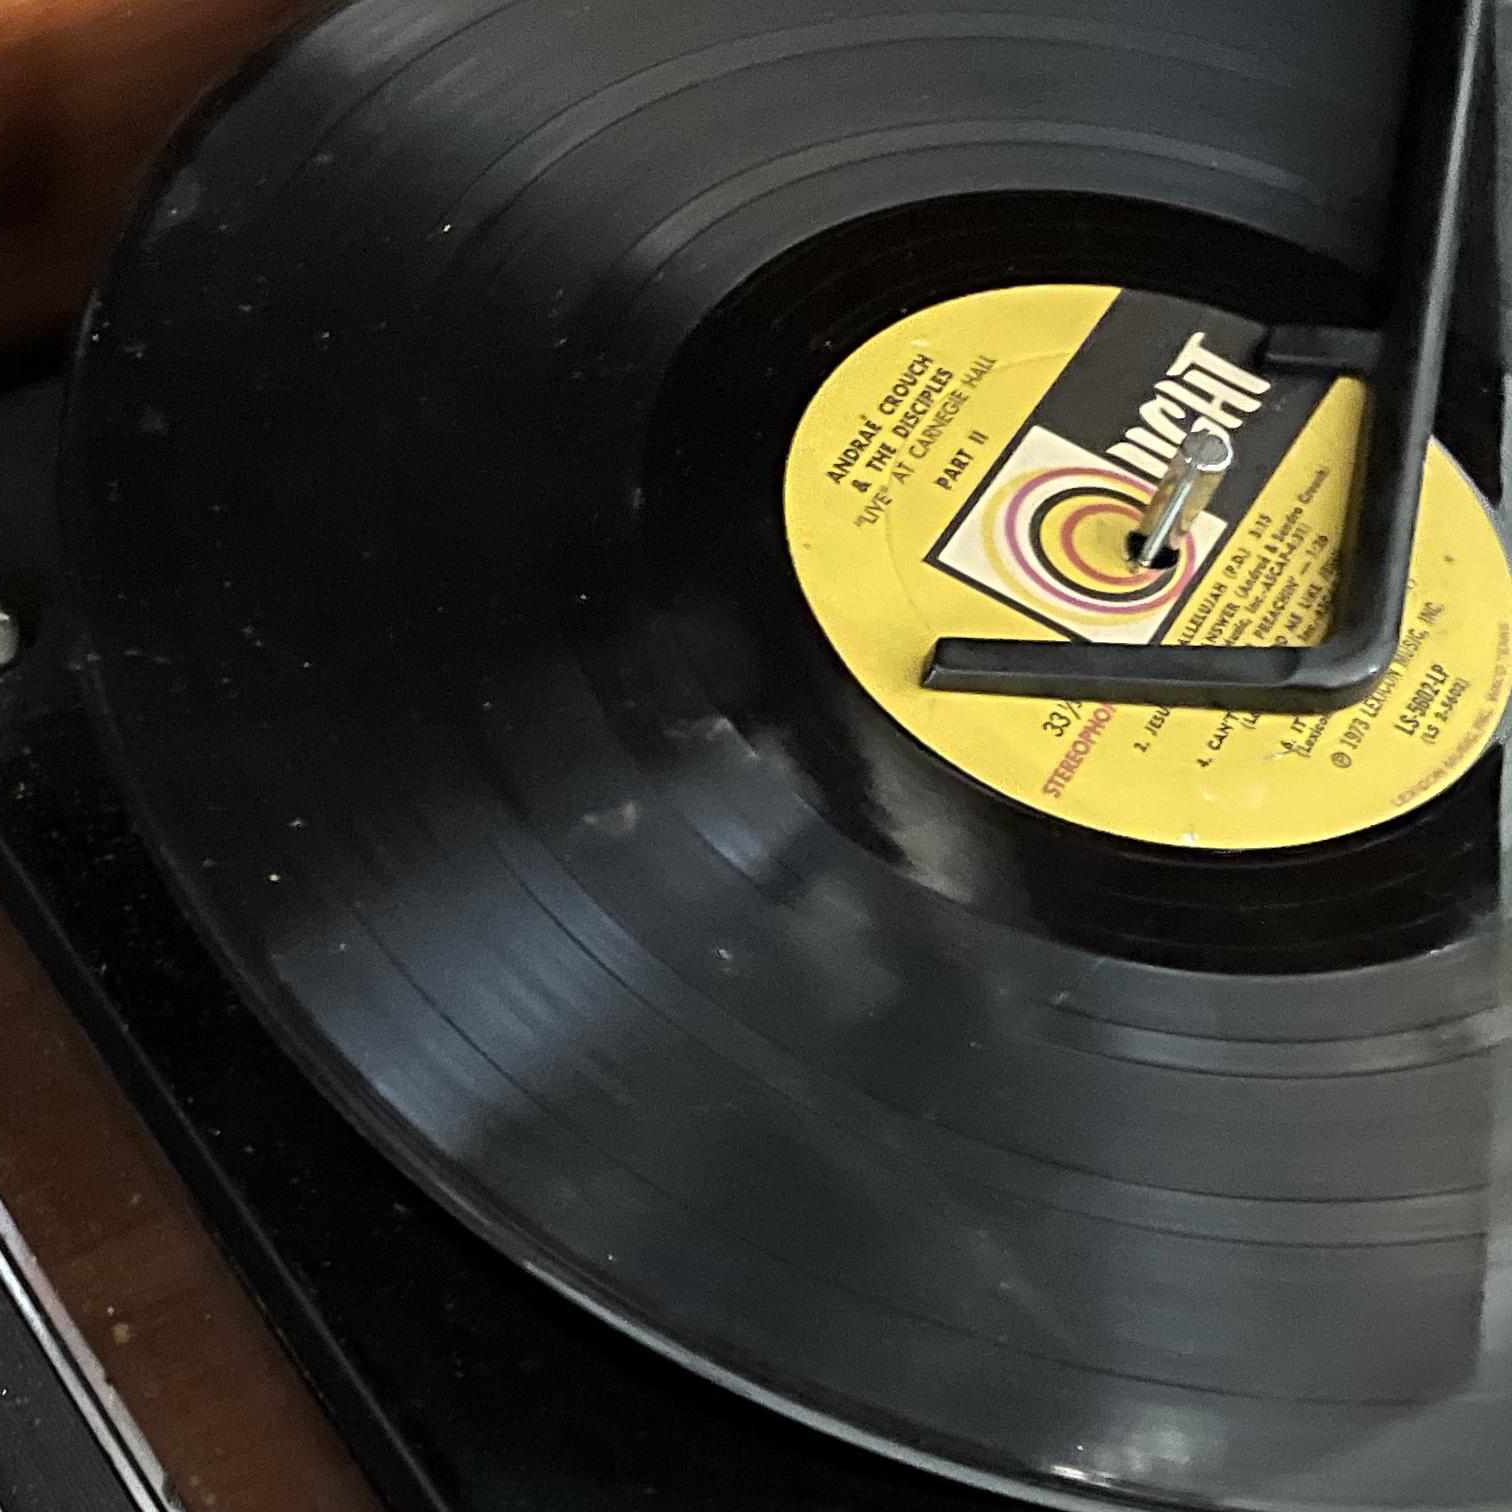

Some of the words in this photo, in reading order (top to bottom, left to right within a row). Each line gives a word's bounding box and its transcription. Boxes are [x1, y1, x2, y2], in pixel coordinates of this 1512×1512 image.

[878, 353, 934, 415] CROUCH
[851, 479, 872, 492] &
[865, 442, 897, 473] THE
[892, 367, 955, 439] DISCIPLES
[892, 462, 915, 484] AT
[908, 390, 969, 459] CARNEGIE
[960, 355, 998, 389] HALL
[934, 447, 974, 491] PART
[967, 429, 989, 445] II
[1178, 583, 1228, 645] ALLELUJAH
[1201, 602, 1241, 645] NSWER
[1042, 710, 1073, 738] 33
[1144, 705, 1172, 737] JESU
[1296, 715, 1332, 758] (Lexico
[1340, 716, 1372, 750] 1973
